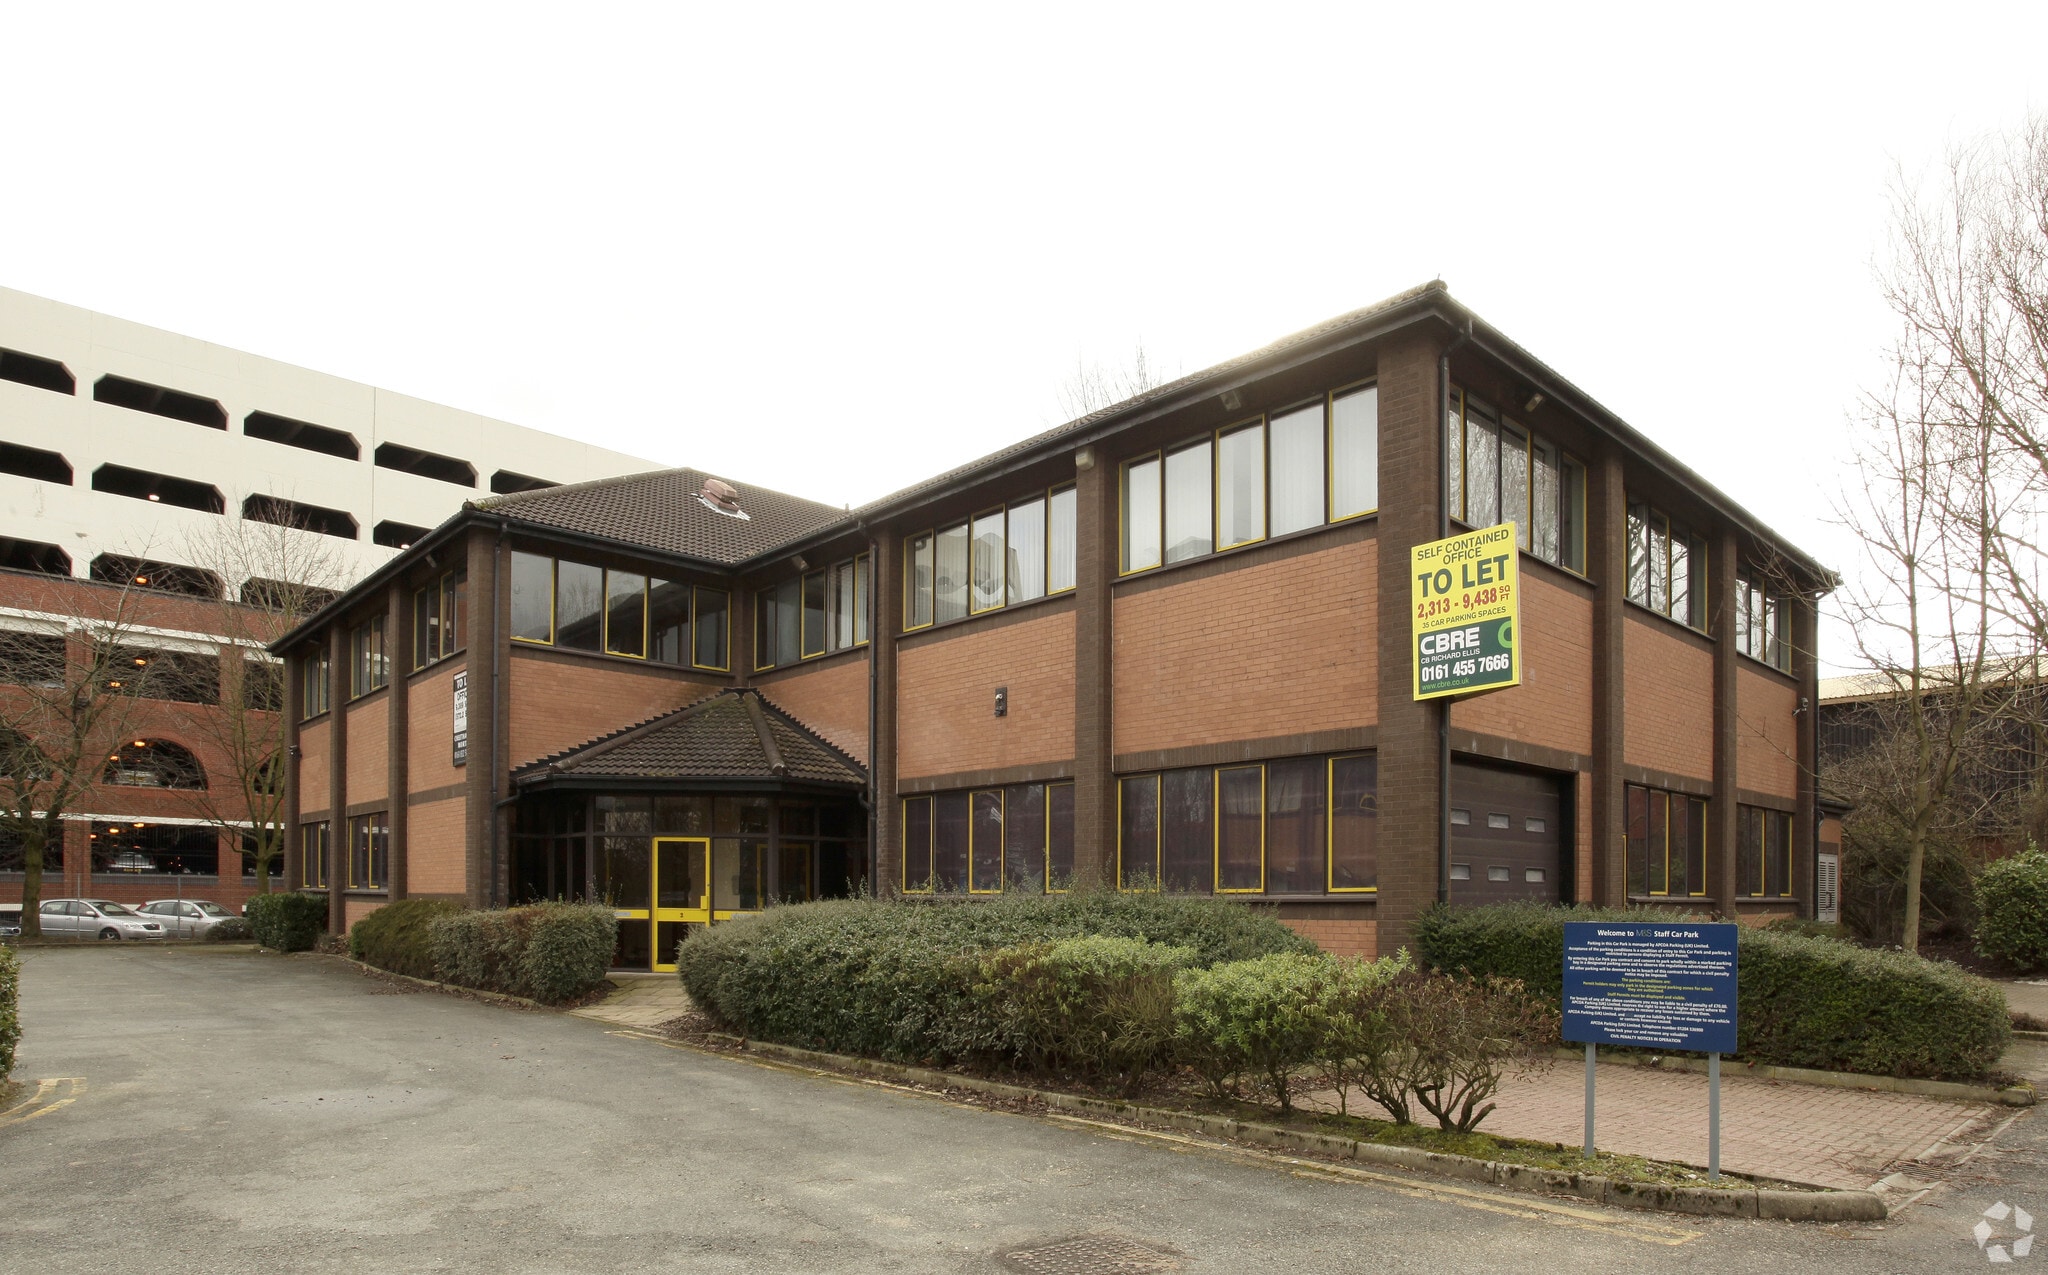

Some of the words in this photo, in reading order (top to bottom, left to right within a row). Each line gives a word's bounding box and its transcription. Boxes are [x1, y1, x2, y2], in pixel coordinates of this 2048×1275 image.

[1417, 545, 1442, 561] SELF
[1445, 529, 1509, 554] CONTAINED
[1443, 547, 1482, 565] OFFICE
[1418, 569, 1452, 598] TO
[1462, 554, 1509, 589] LET
[1417, 598, 1450, 620] 2,313
[1463, 588, 1497, 610] 9,438
[1499, 584, 1510, 594] SQ
[1500, 593, 1510, 602] FT
[1431, 619, 1444, 628] CAR
[1446, 612, 1477, 626] PARKING
[1478, 606, 1507, 618] SPACES
[1420, 627, 1480, 655] CBRE
[1422, 664, 1449, 682] 0161
[1452, 659, 1476, 677] 455
[1480, 653, 1509, 673] 7666
[1431, 651, 1461, 663] RICHARD
[1462, 648, 1480, 657] ELLIS
[1422, 677, 1470, 691] www.cbre.co.uk
